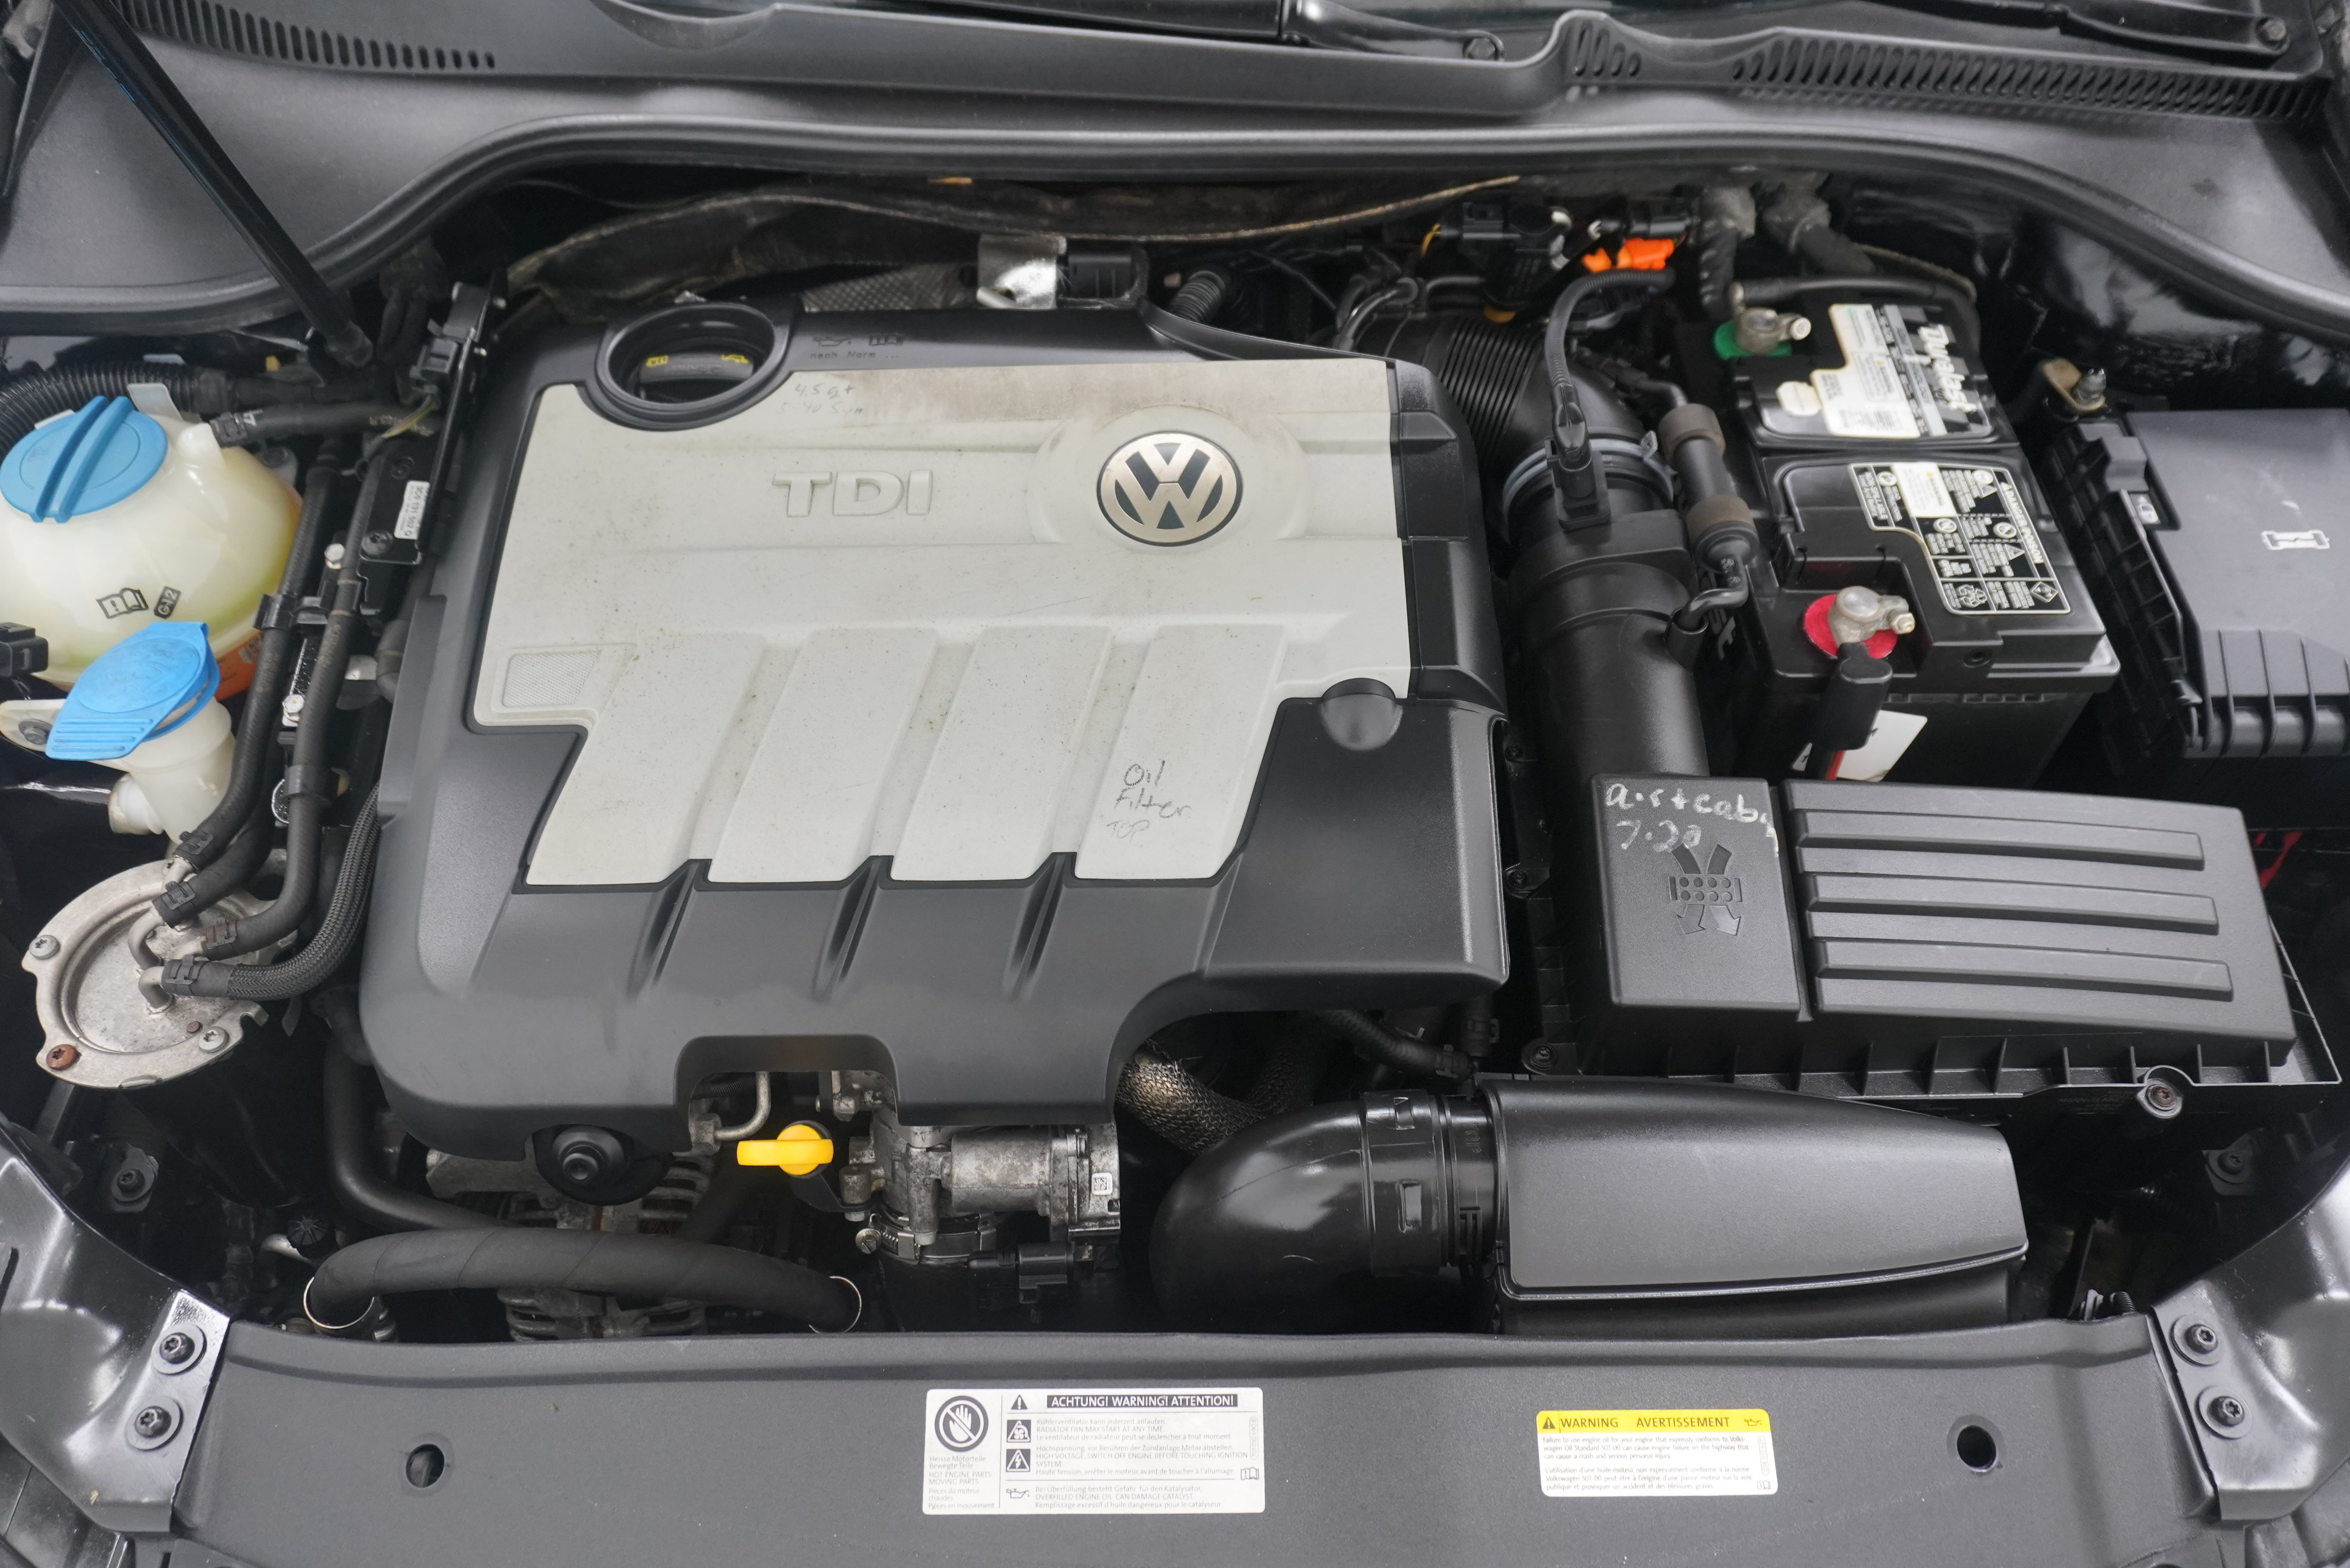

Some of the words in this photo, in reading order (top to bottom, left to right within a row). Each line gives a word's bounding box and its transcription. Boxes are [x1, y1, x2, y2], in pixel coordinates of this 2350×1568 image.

[1918, 323, 1977, 413] Duralast
[772, 469, 933, 518] TDI
[1124, 760, 1165, 787] Oil
[1114, 787, 1193, 819] Filter
[1051, 1396, 1108, 1407] ACHTUNG!
[1111, 1396, 1168, 1407] WARNING!
[1171, 1395, 1234, 1406] ATTENTION!
[1107, 1417, 1134, 1426] jederzeit
[1560, 1418, 1618, 1427] WARNING
[1636, 1417, 1730, 1427] AVERTISSEMENT
[1035, 1502, 1075, 1510] Remplissage
[1128, 1501, 1162, 1509] dangereux
